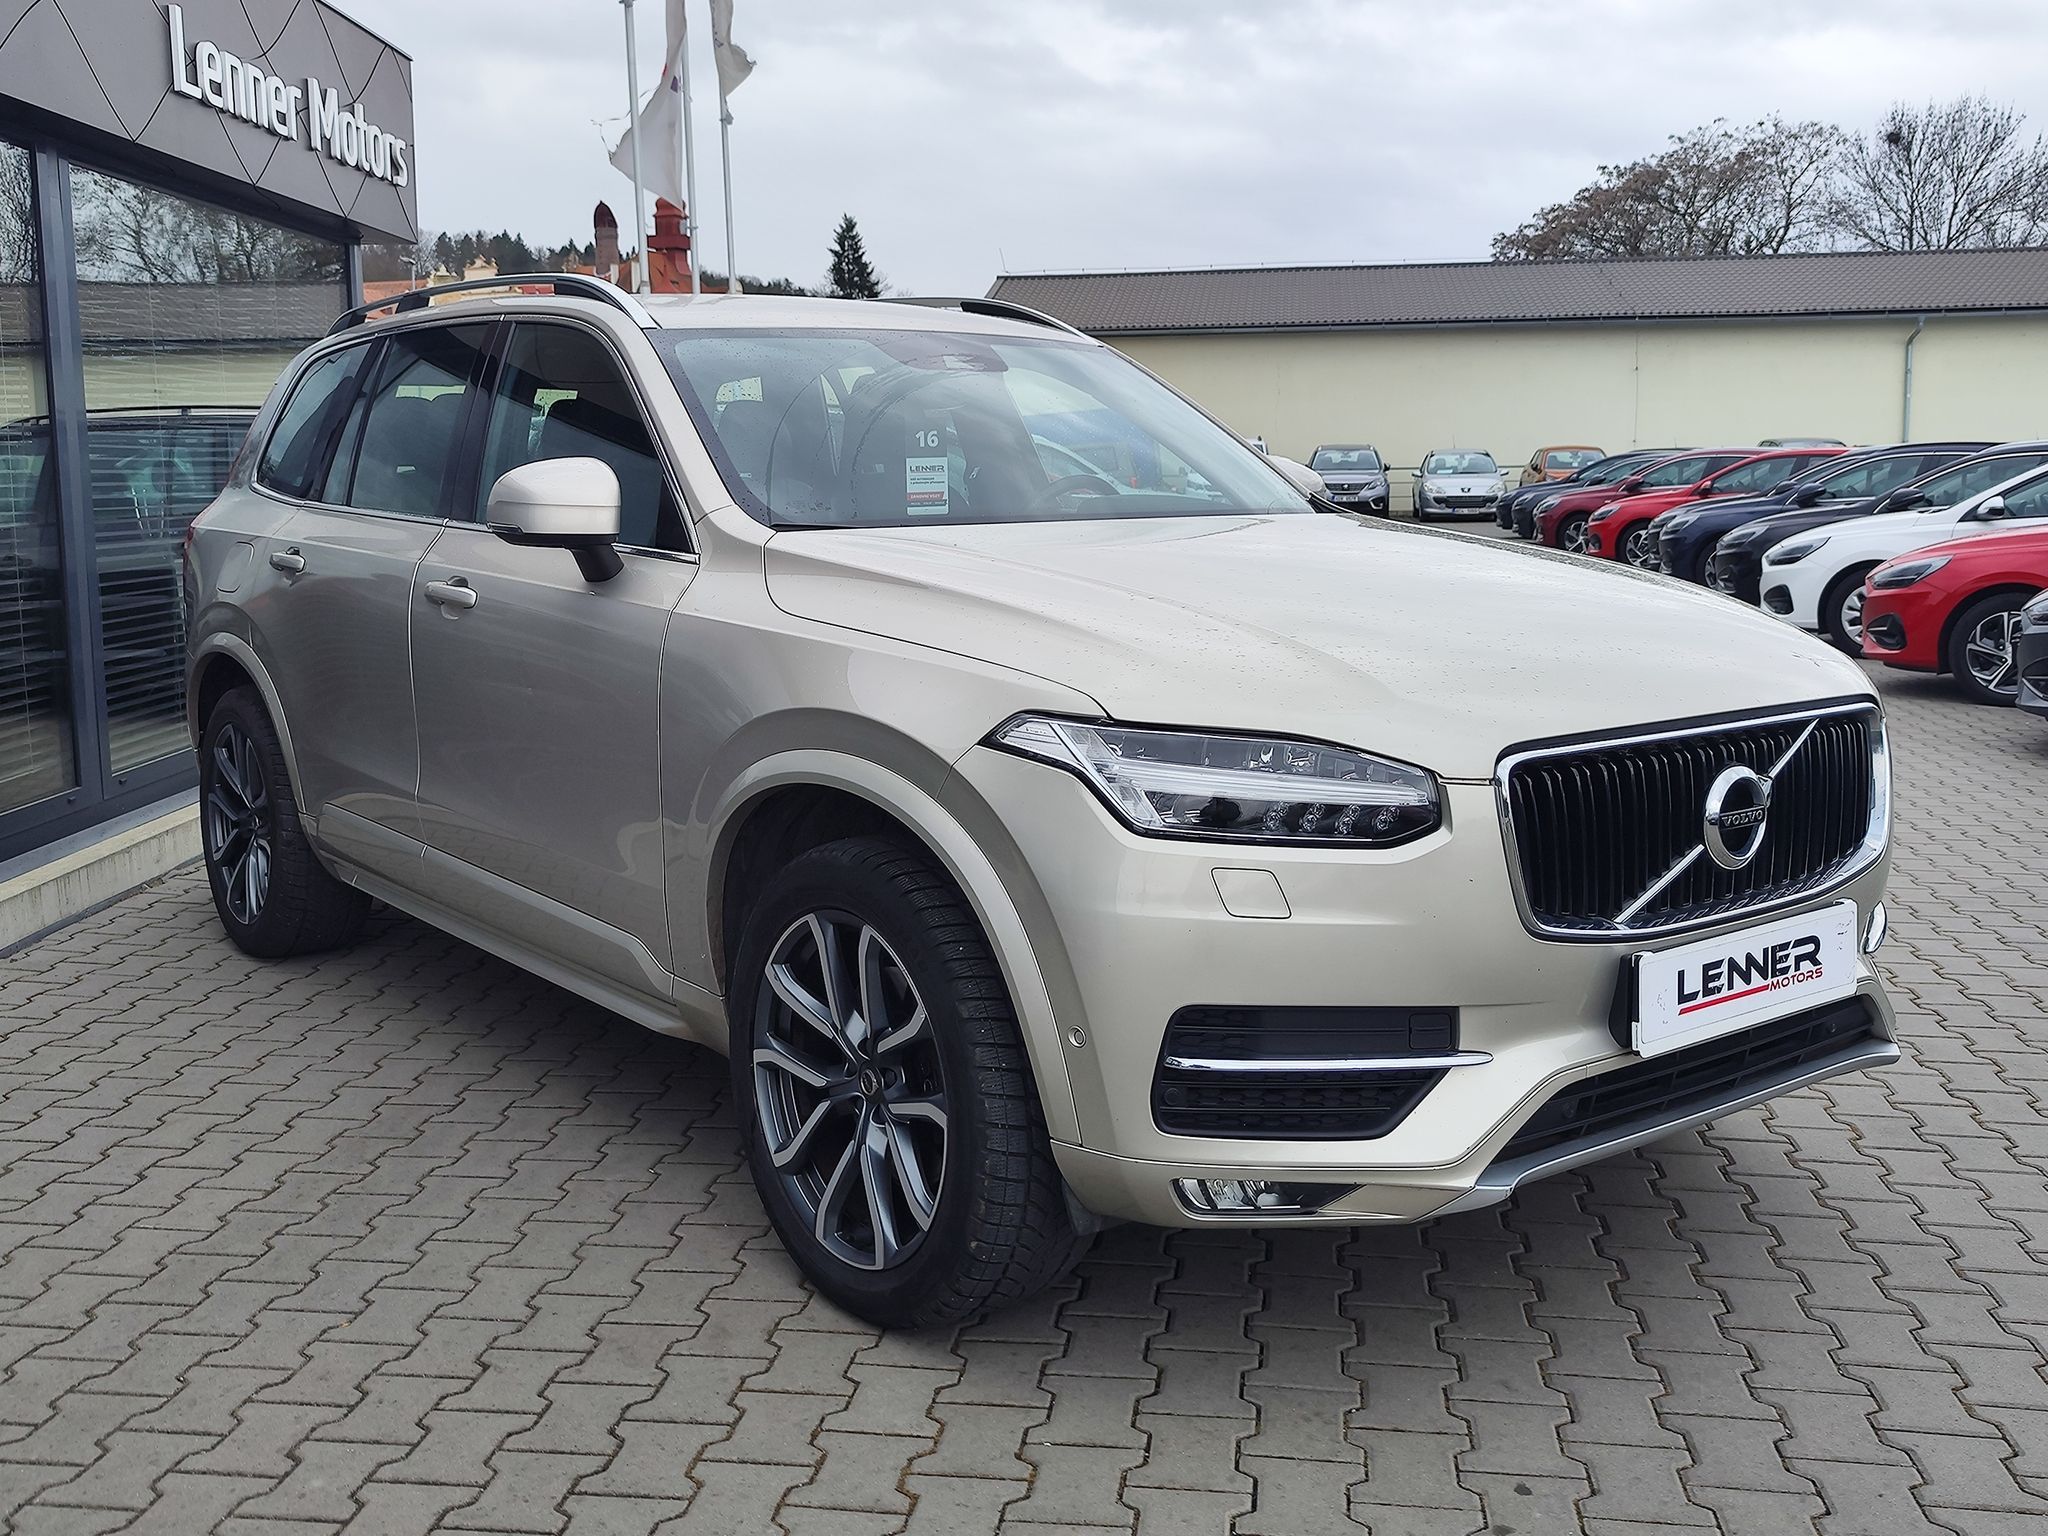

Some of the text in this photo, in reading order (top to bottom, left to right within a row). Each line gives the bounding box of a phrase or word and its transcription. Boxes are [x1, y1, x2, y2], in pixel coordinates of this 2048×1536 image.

[168, 4, 409, 188] Lenner Motors
[915, 430, 939, 448] 16
[909, 464, 945, 473] LENNER
[1721, 810, 1763, 826] VOLVO
[1677, 935, 1822, 1005] LENNER
[1769, 966, 1823, 991] MOTORS
